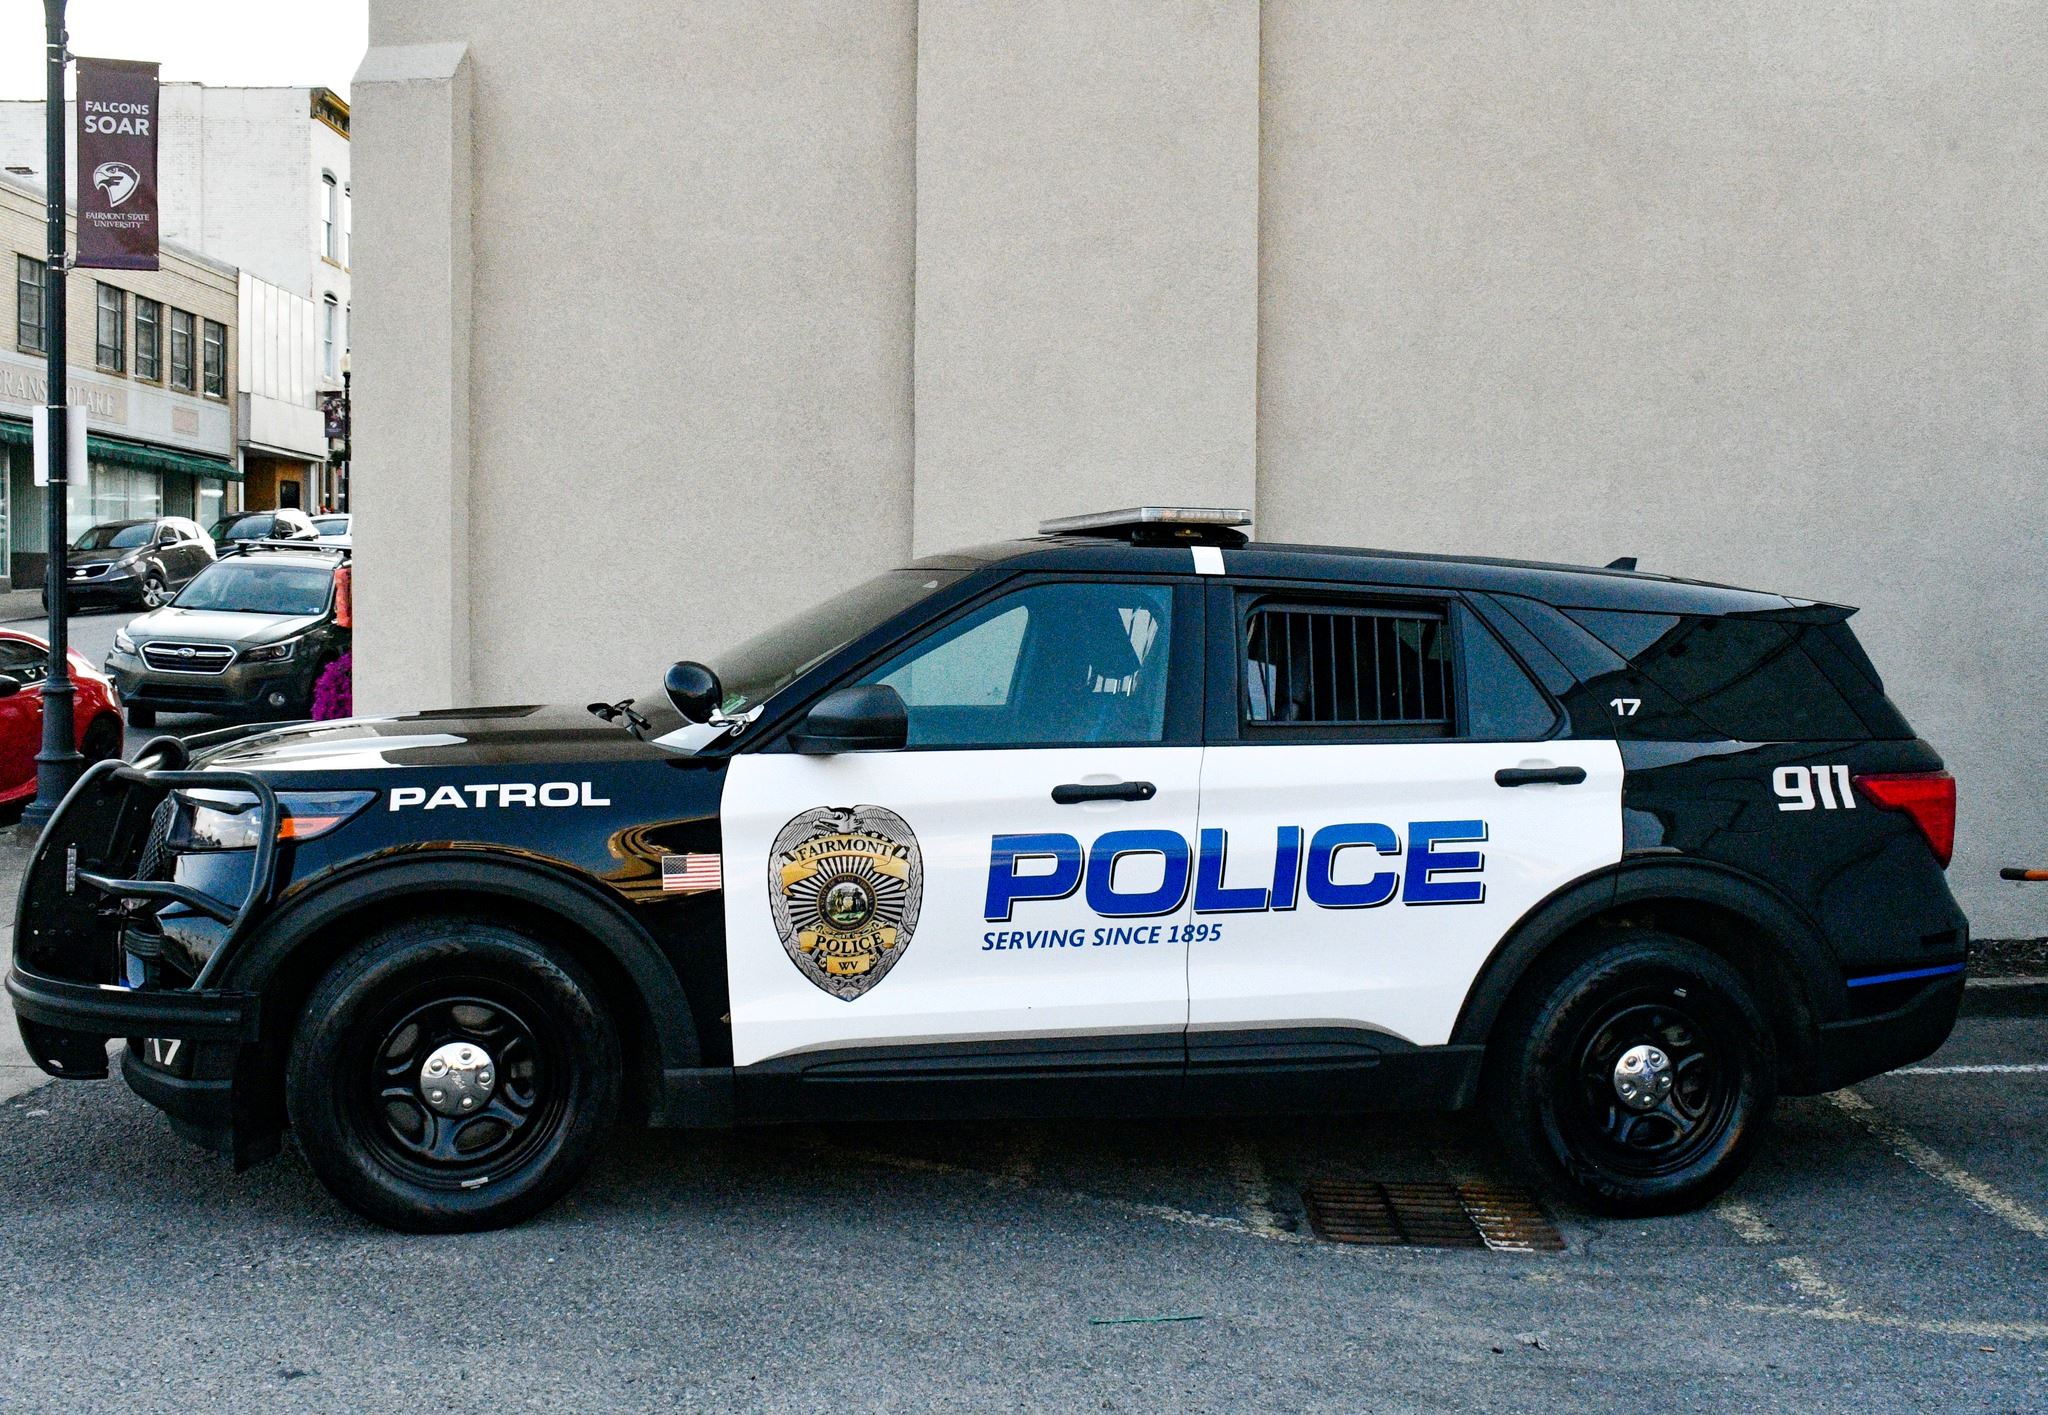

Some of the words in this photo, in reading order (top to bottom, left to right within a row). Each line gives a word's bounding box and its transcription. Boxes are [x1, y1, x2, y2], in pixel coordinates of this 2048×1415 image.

[85, 101, 150, 115] FALCONS
[84, 115, 150, 136] SOAR
[85, 212, 125, 220] FAIRMONT
[127, 213, 150, 221] STATE
[94, 220, 141, 229] UNIVERSITY
[0, 368, 48, 402] RANS
[66, 385, 115, 417] QUARE
[1610, 698, 1641, 716] 17
[389, 781, 611, 812] PATROL
[1772, 764, 1857, 811] 911
[797, 838, 892, 861] FAIRMONT
[983, 819, 1489, 923] POLICE
[814, 931, 885, 953] POLICE
[982, 928, 1086, 951] SERVING
[1092, 926, 1162, 946] SINCE
[1167, 923, 1223, 943] 1895
[838, 961, 858, 971] WV
[148, 1038, 181, 1066] 17
